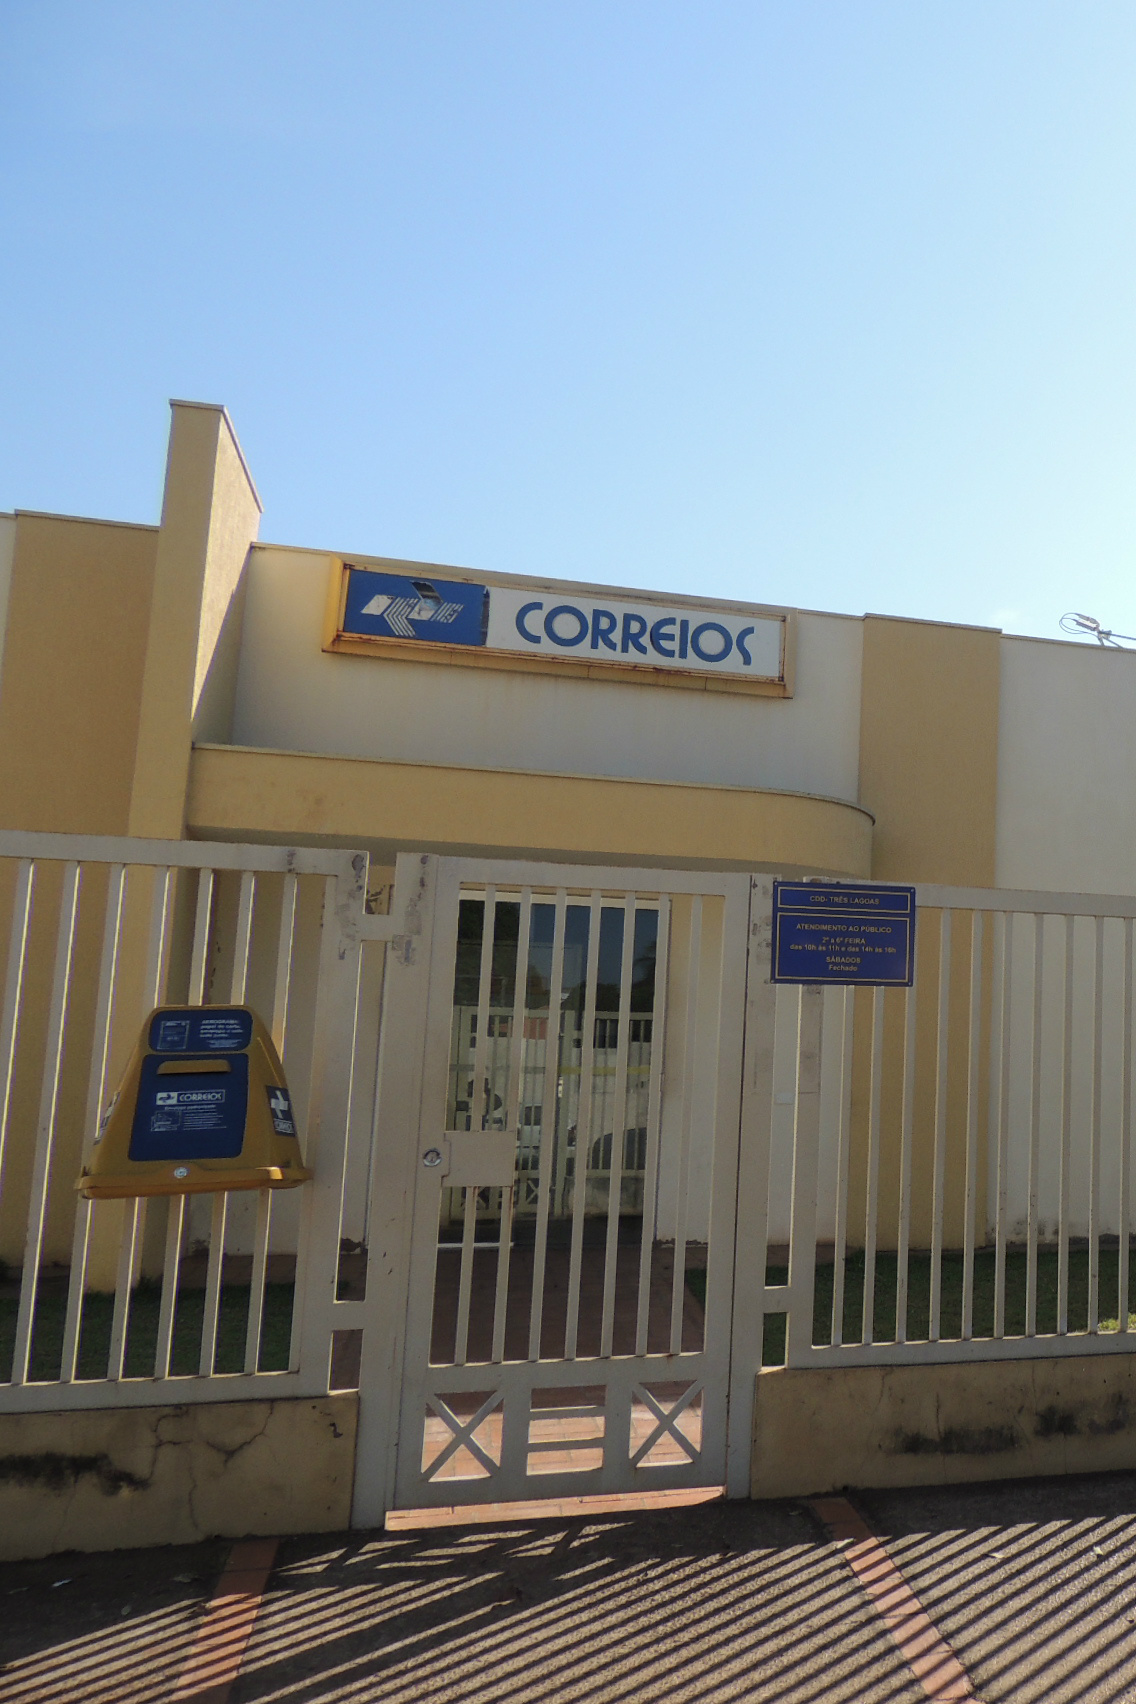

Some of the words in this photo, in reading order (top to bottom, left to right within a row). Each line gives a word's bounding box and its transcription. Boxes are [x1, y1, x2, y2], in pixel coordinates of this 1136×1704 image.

[515, 601, 755, 666] CORREIOS
[829, 895, 848, 903] TRÊS
[796, 923, 847, 931] ATENDIMENTO
[179, 1093, 222, 1102] CORREIOS
